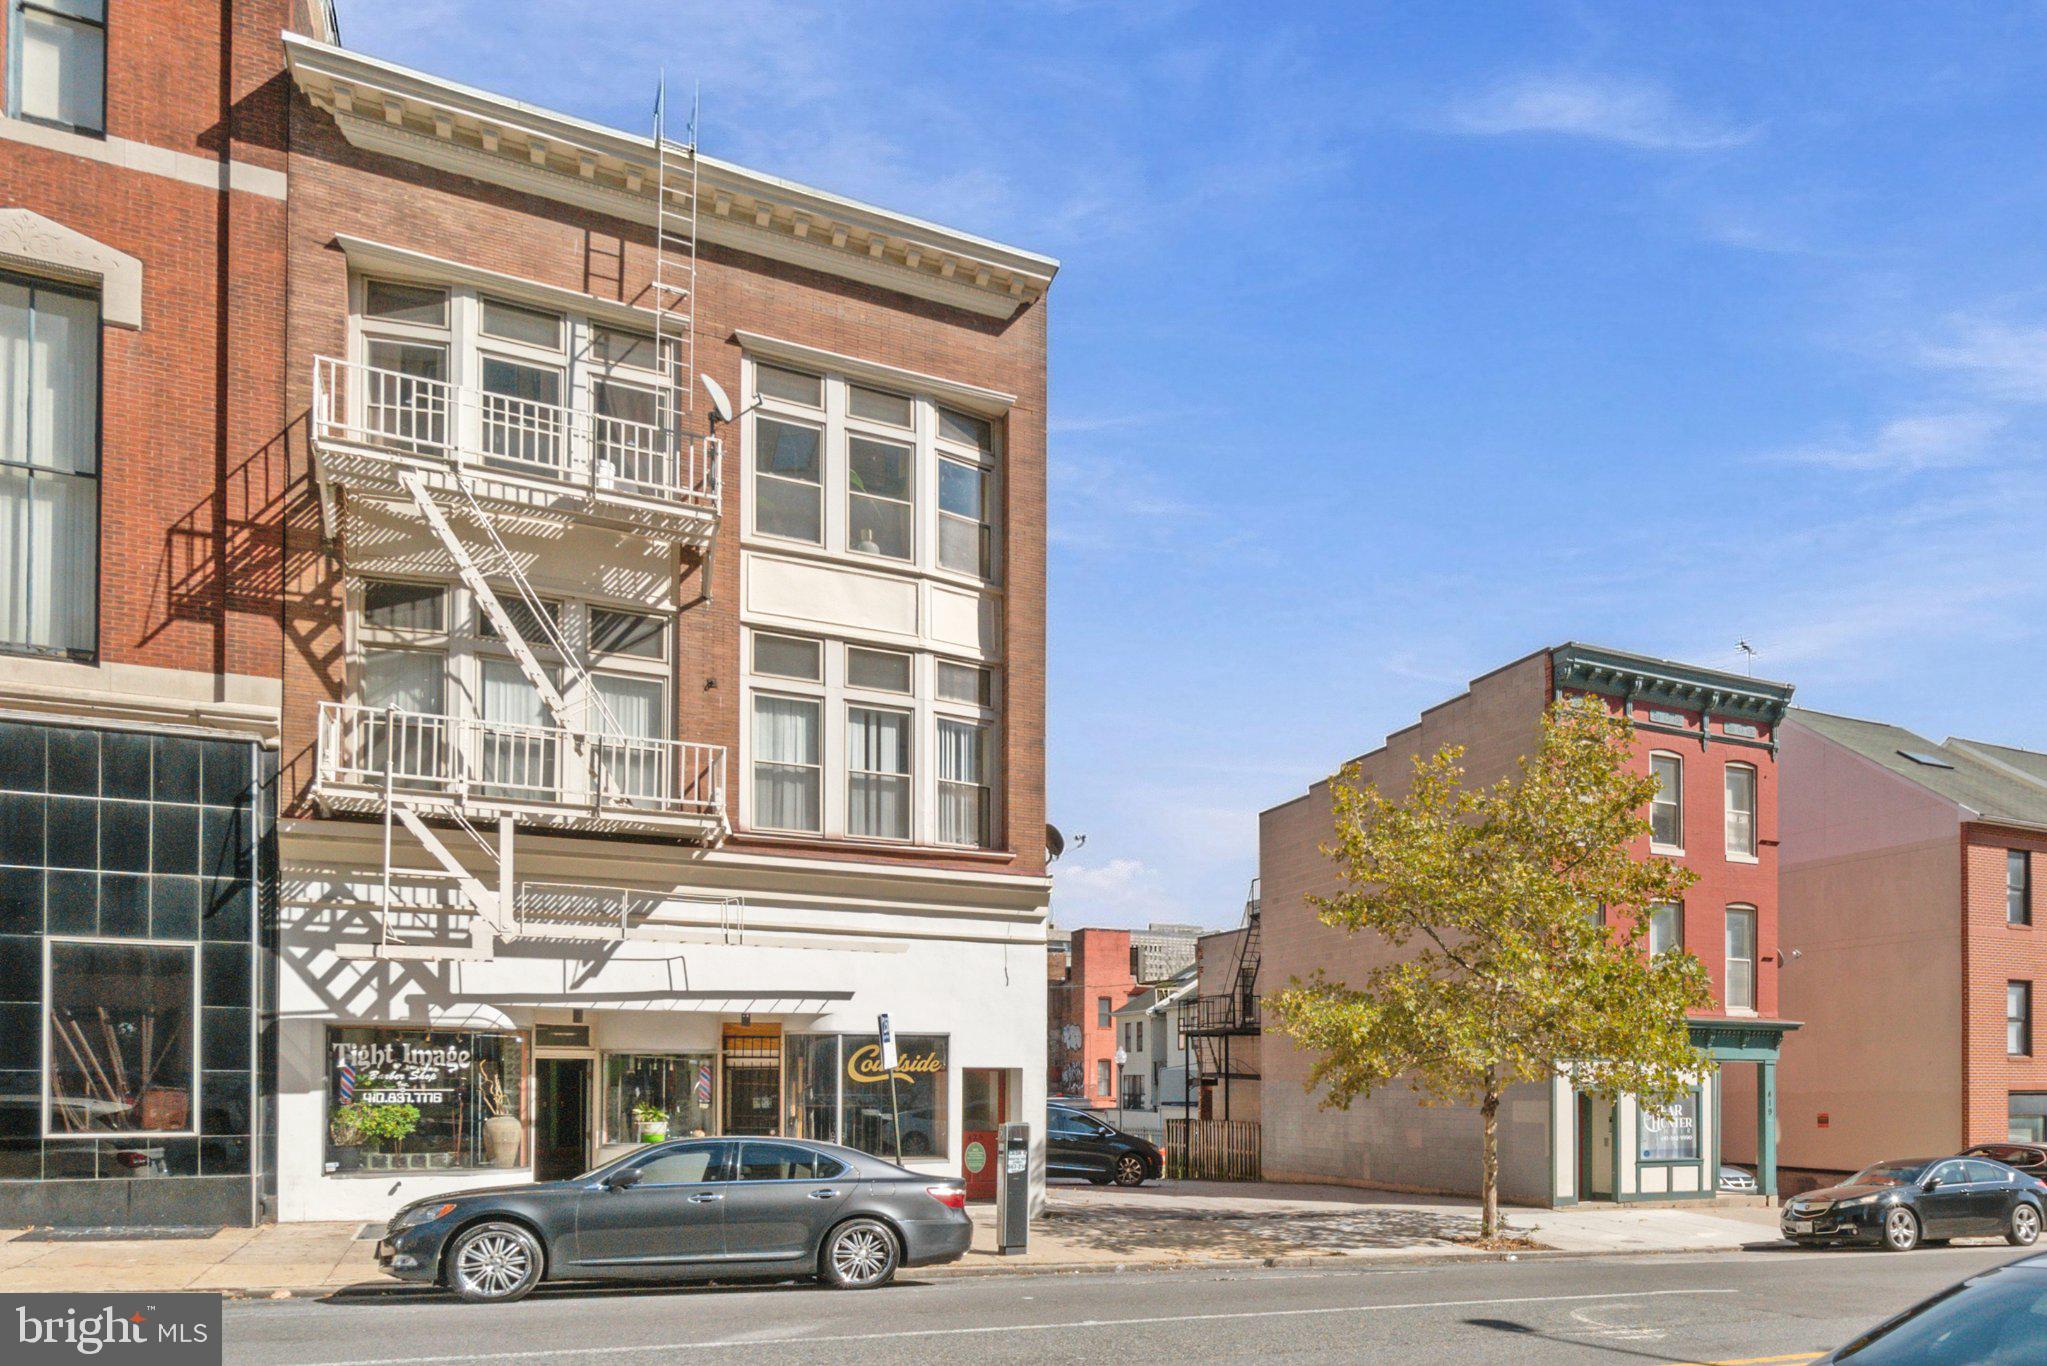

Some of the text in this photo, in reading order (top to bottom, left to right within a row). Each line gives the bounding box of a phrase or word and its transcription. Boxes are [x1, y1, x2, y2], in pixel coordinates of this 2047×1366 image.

[332, 1043, 471, 1073] Tight Image
[847, 1043, 942, 1084] Coutside
[367, 1069, 438, 1082] Barber Shop
